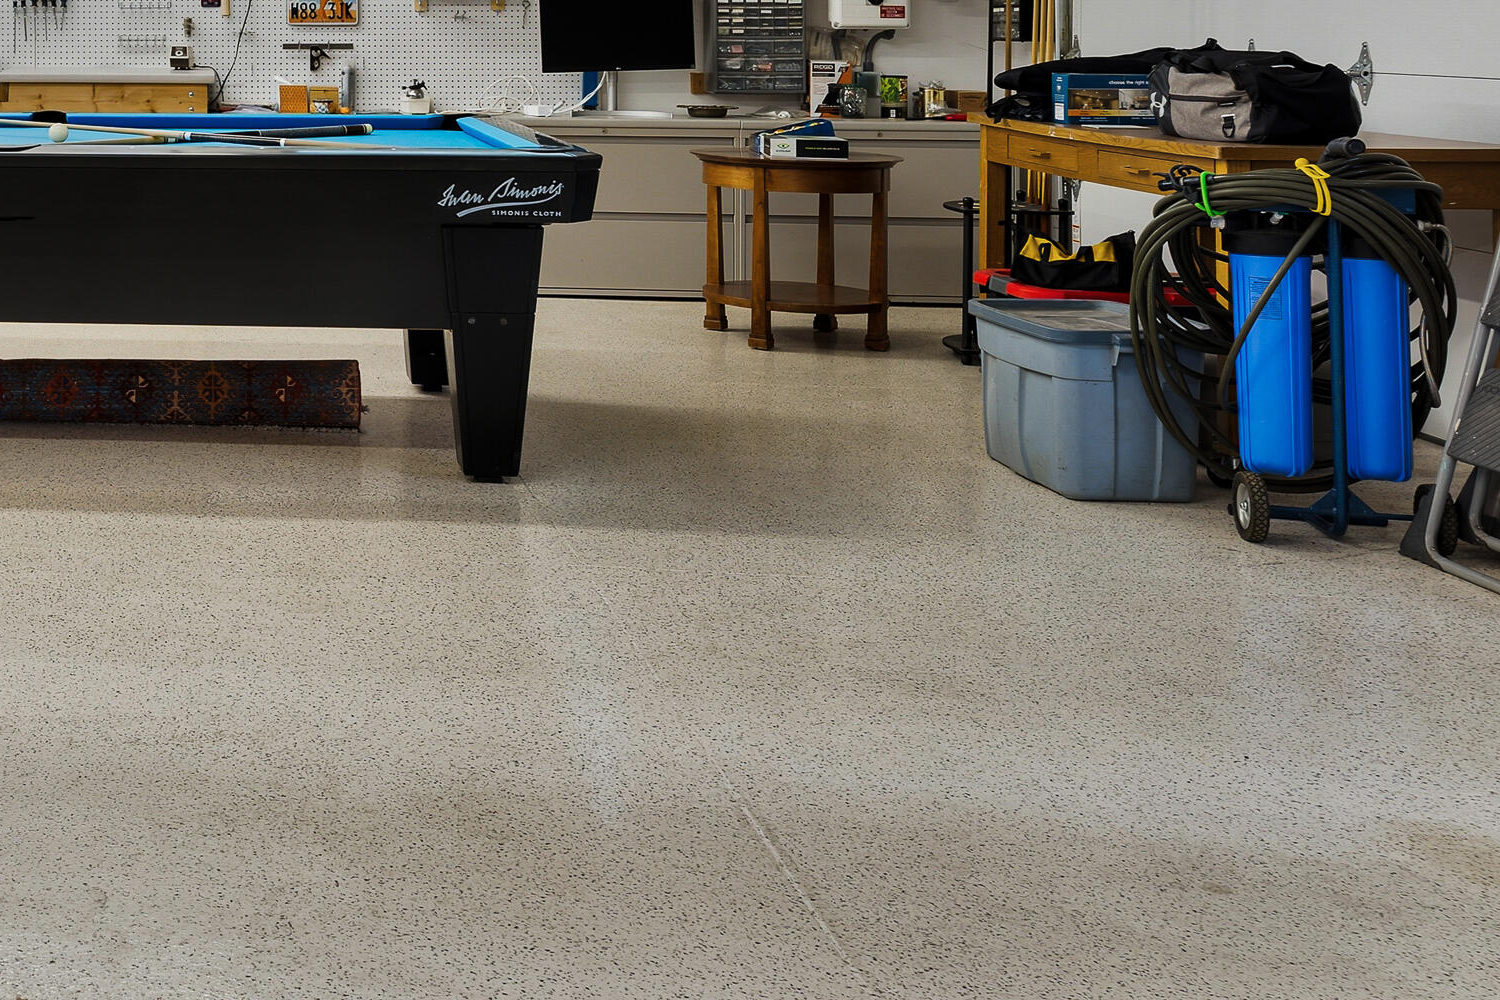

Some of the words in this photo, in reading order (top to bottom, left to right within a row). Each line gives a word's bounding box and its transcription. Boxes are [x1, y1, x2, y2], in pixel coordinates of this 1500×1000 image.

[328, 2, 353, 20] 3JK
[487, 177, 565, 202] Simonis
[491, 209, 529, 217] SIMONIS
